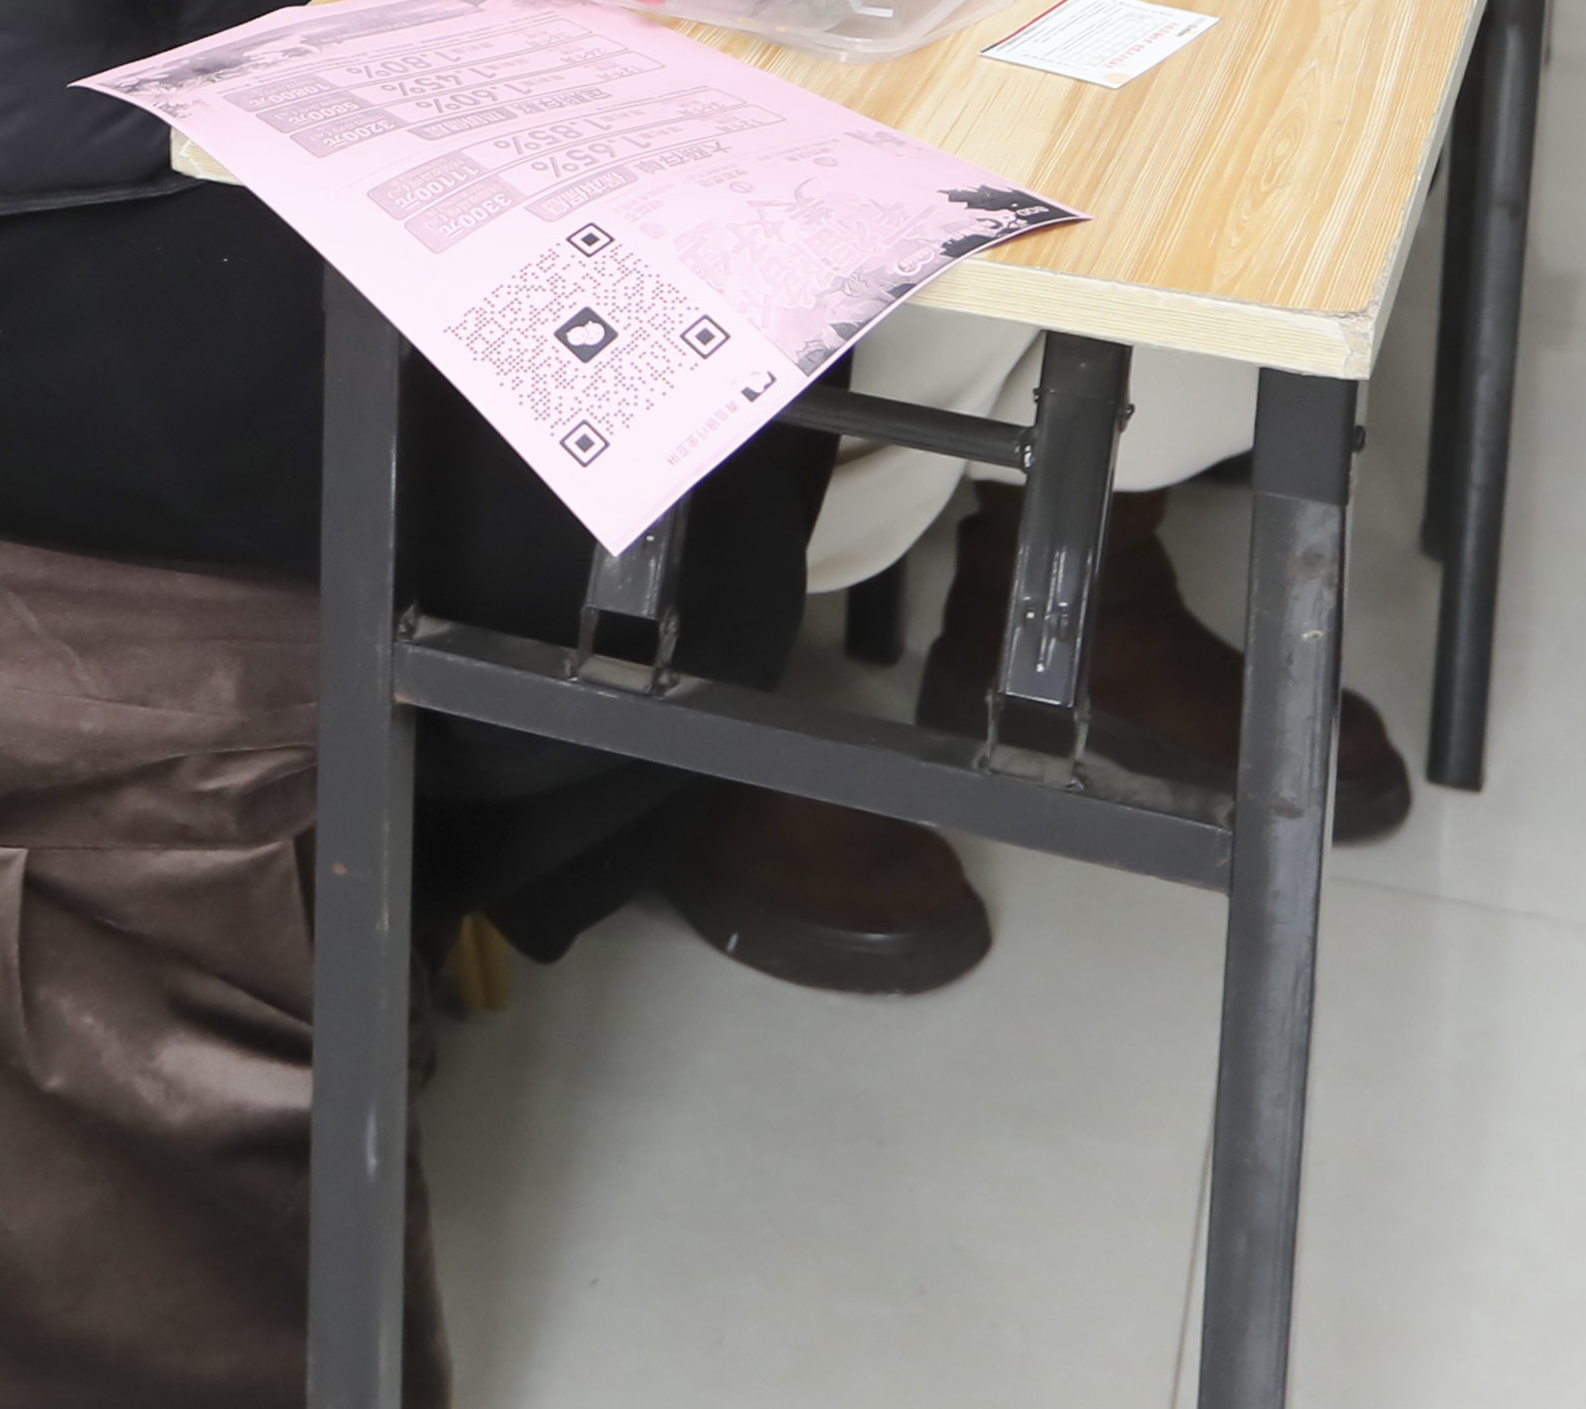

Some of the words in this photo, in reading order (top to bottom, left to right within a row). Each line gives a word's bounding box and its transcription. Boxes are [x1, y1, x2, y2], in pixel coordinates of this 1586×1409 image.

[344, 51, 460, 79] 1.80%
[247, 81, 332, 107] 10800元
[379, 68, 496, 96] 1.45%
[286, 100, 361, 126] 5800元
[413, 83, 531, 113] 1.60%
[319, 118, 397, 149] 3200元
[490, 118, 611, 155] 1.85%
[527, 135, 649, 178] 1.65%
[630, 139, 729, 177] 大额存单
[391, 164, 478, 210] 11100元
[436, 192, 514, 238] 3300元
